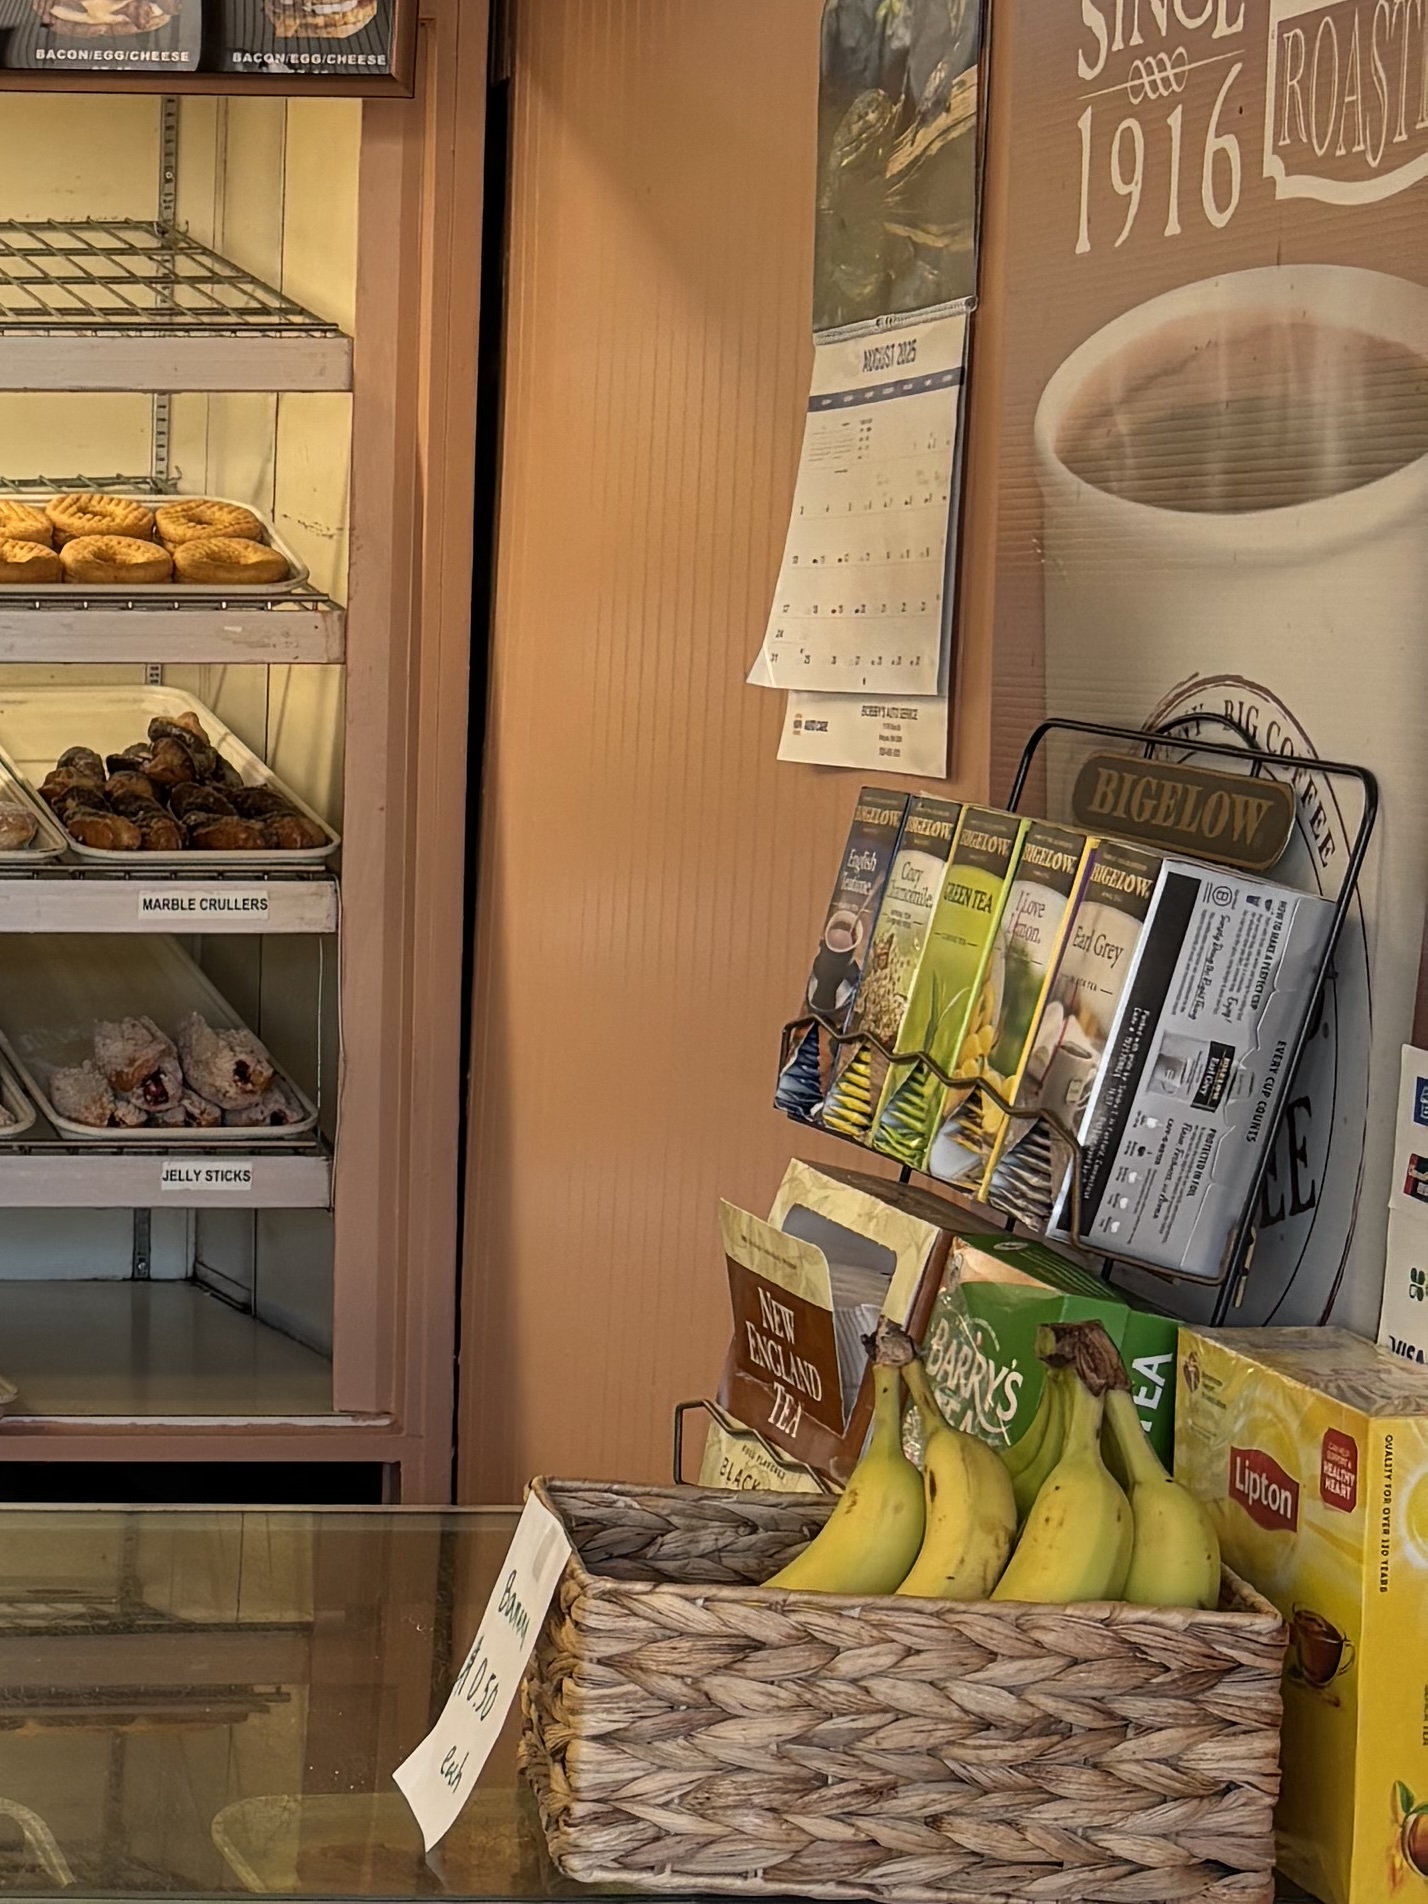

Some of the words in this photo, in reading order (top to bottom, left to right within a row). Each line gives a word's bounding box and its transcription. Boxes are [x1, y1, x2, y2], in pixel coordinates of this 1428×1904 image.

[1075, 62, 1242, 254] 1916
[862, 344, 894, 373] AUGUST
[1223, 700, 1261, 741] BIG
[1087, 766, 1274, 855] BIGELOW
[143, 898, 196, 910] MARBLE
[199, 898, 268, 910] CRULLERS
[1073, 926, 1093, 950] Earl
[1093, 934, 1124, 968] Grey
[162, 1169, 202, 1182] JELLY
[205, 1169, 251, 1182] STICKS
[758, 1287, 795, 1344] NEW
[745, 1321, 822, 1401] ENGLAND
[768, 1382, 804, 1438] TEA
[1235, 1457, 1292, 1519] Lipton
[1323, 1460, 1356, 1486] HEALTHY
[1325, 1478, 1351, 1500] HEART
